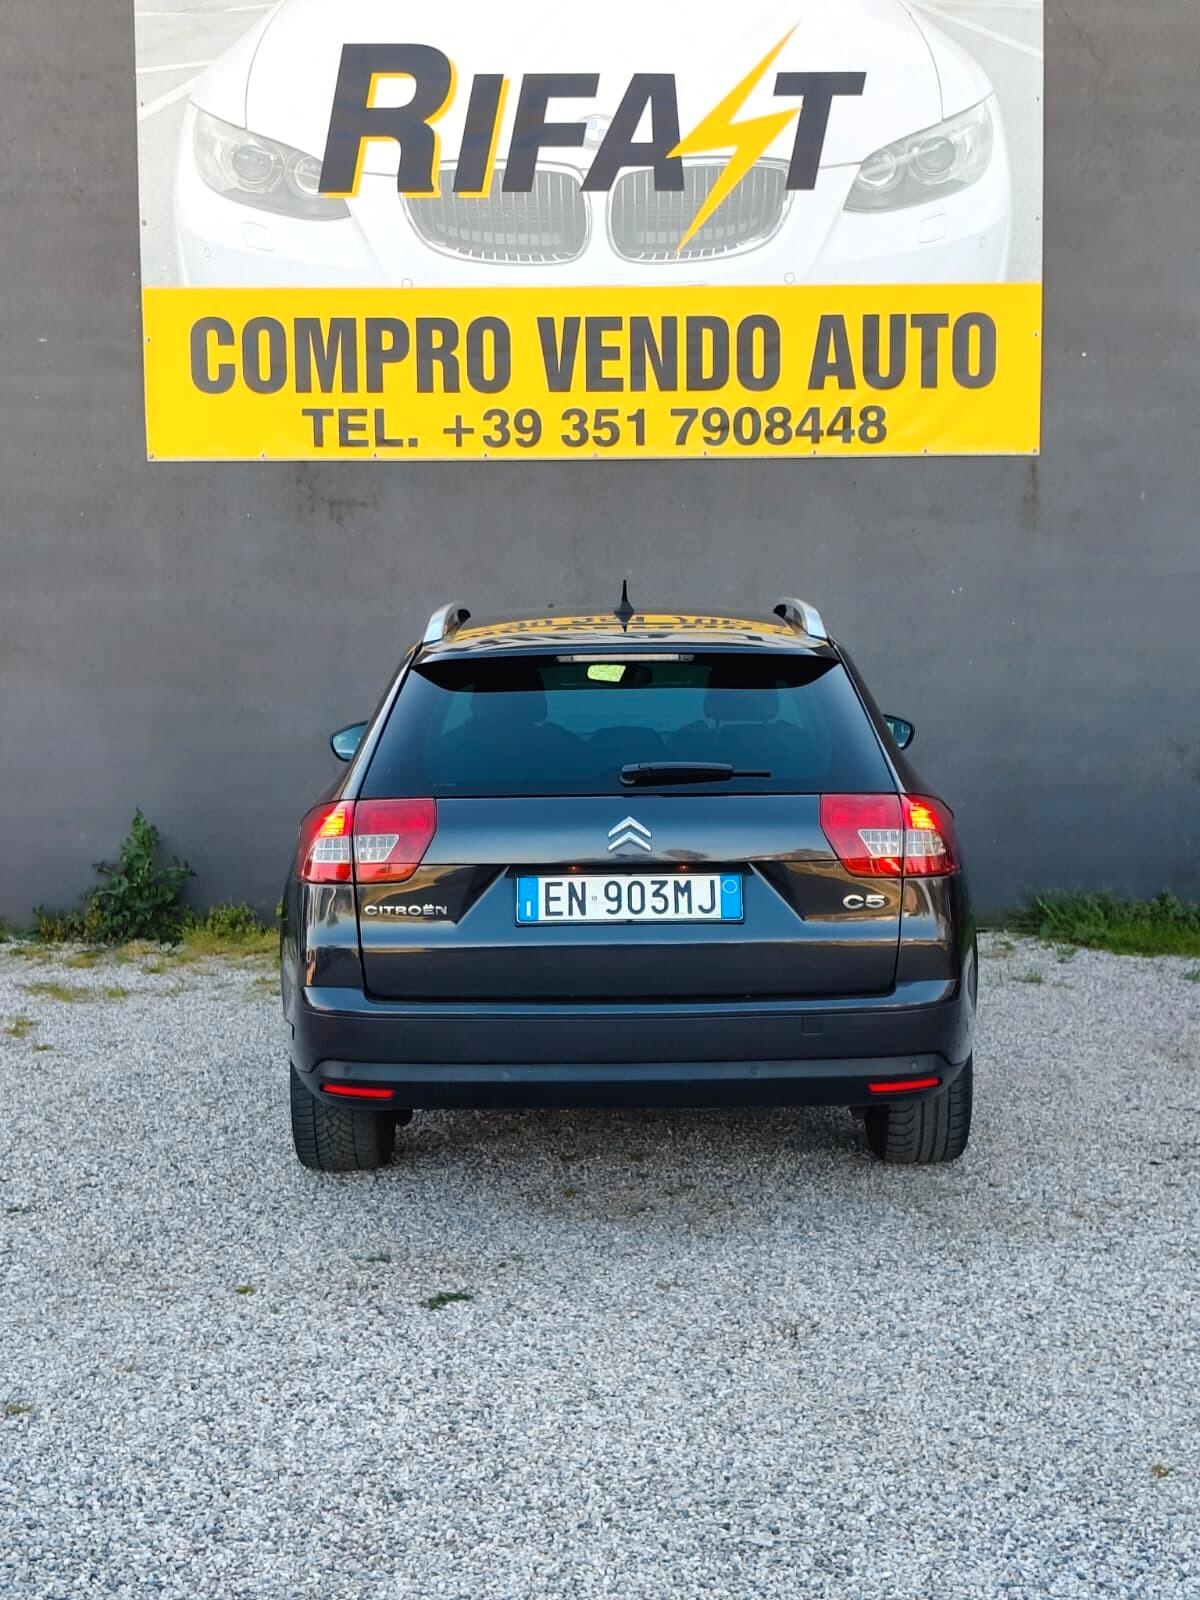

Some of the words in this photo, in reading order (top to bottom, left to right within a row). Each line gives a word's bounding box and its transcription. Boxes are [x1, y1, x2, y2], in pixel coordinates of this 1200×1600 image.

[190, 316, 511, 394] COMPRO
[536, 314, 781, 393] VENDO
[807, 312, 996, 391] AUTO
[302, 408, 418, 447] TEL.
[443, 408, 542, 448] +39
[561, 408, 645, 447] 351
[670, 405, 887, 446] 7908448
[544, 881, 587, 916] EN
[603, 879, 717, 916] 903MJ
[842, 894, 886, 910] C5
